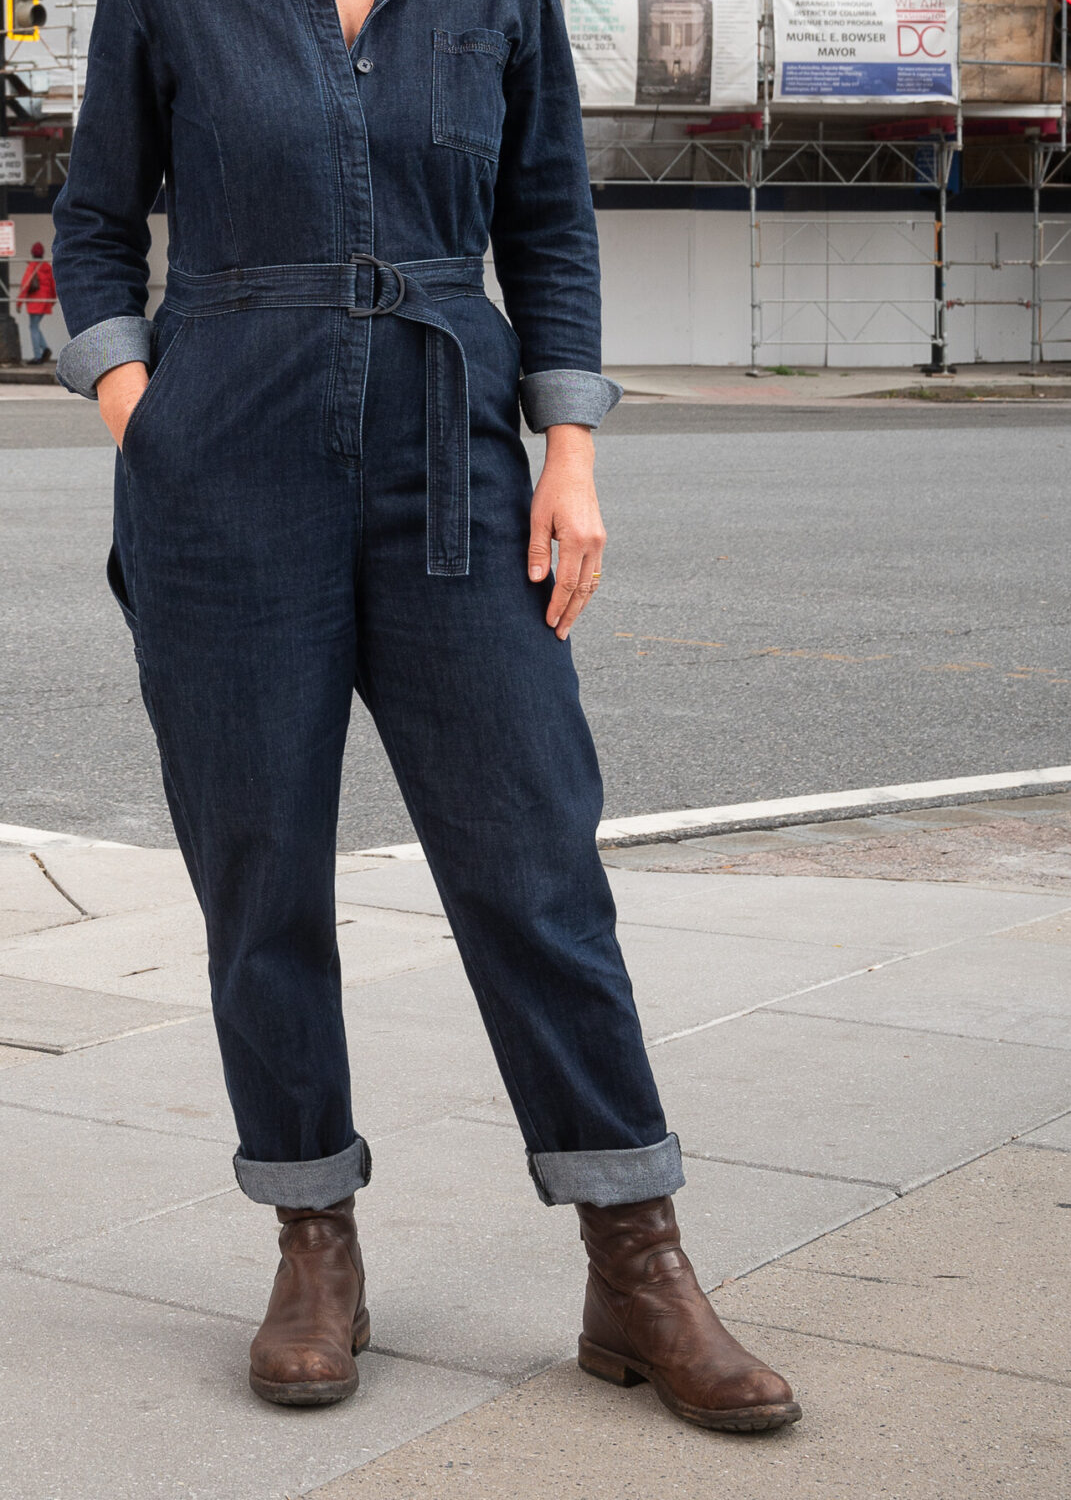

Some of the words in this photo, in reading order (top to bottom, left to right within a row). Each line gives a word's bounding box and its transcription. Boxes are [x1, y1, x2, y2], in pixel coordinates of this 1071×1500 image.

[824, 19, 845, 27] BOND
[846, 19, 884, 27] PROGRAM
[570, 33, 613, 41] REOPENS
[786, 32, 827, 43] MURIEL
[830, 32, 840, 43] E.
[841, 32, 887, 43] BOWSER
[896, 24, 947, 58] DC
[817, 47, 857, 57] MAYOR
